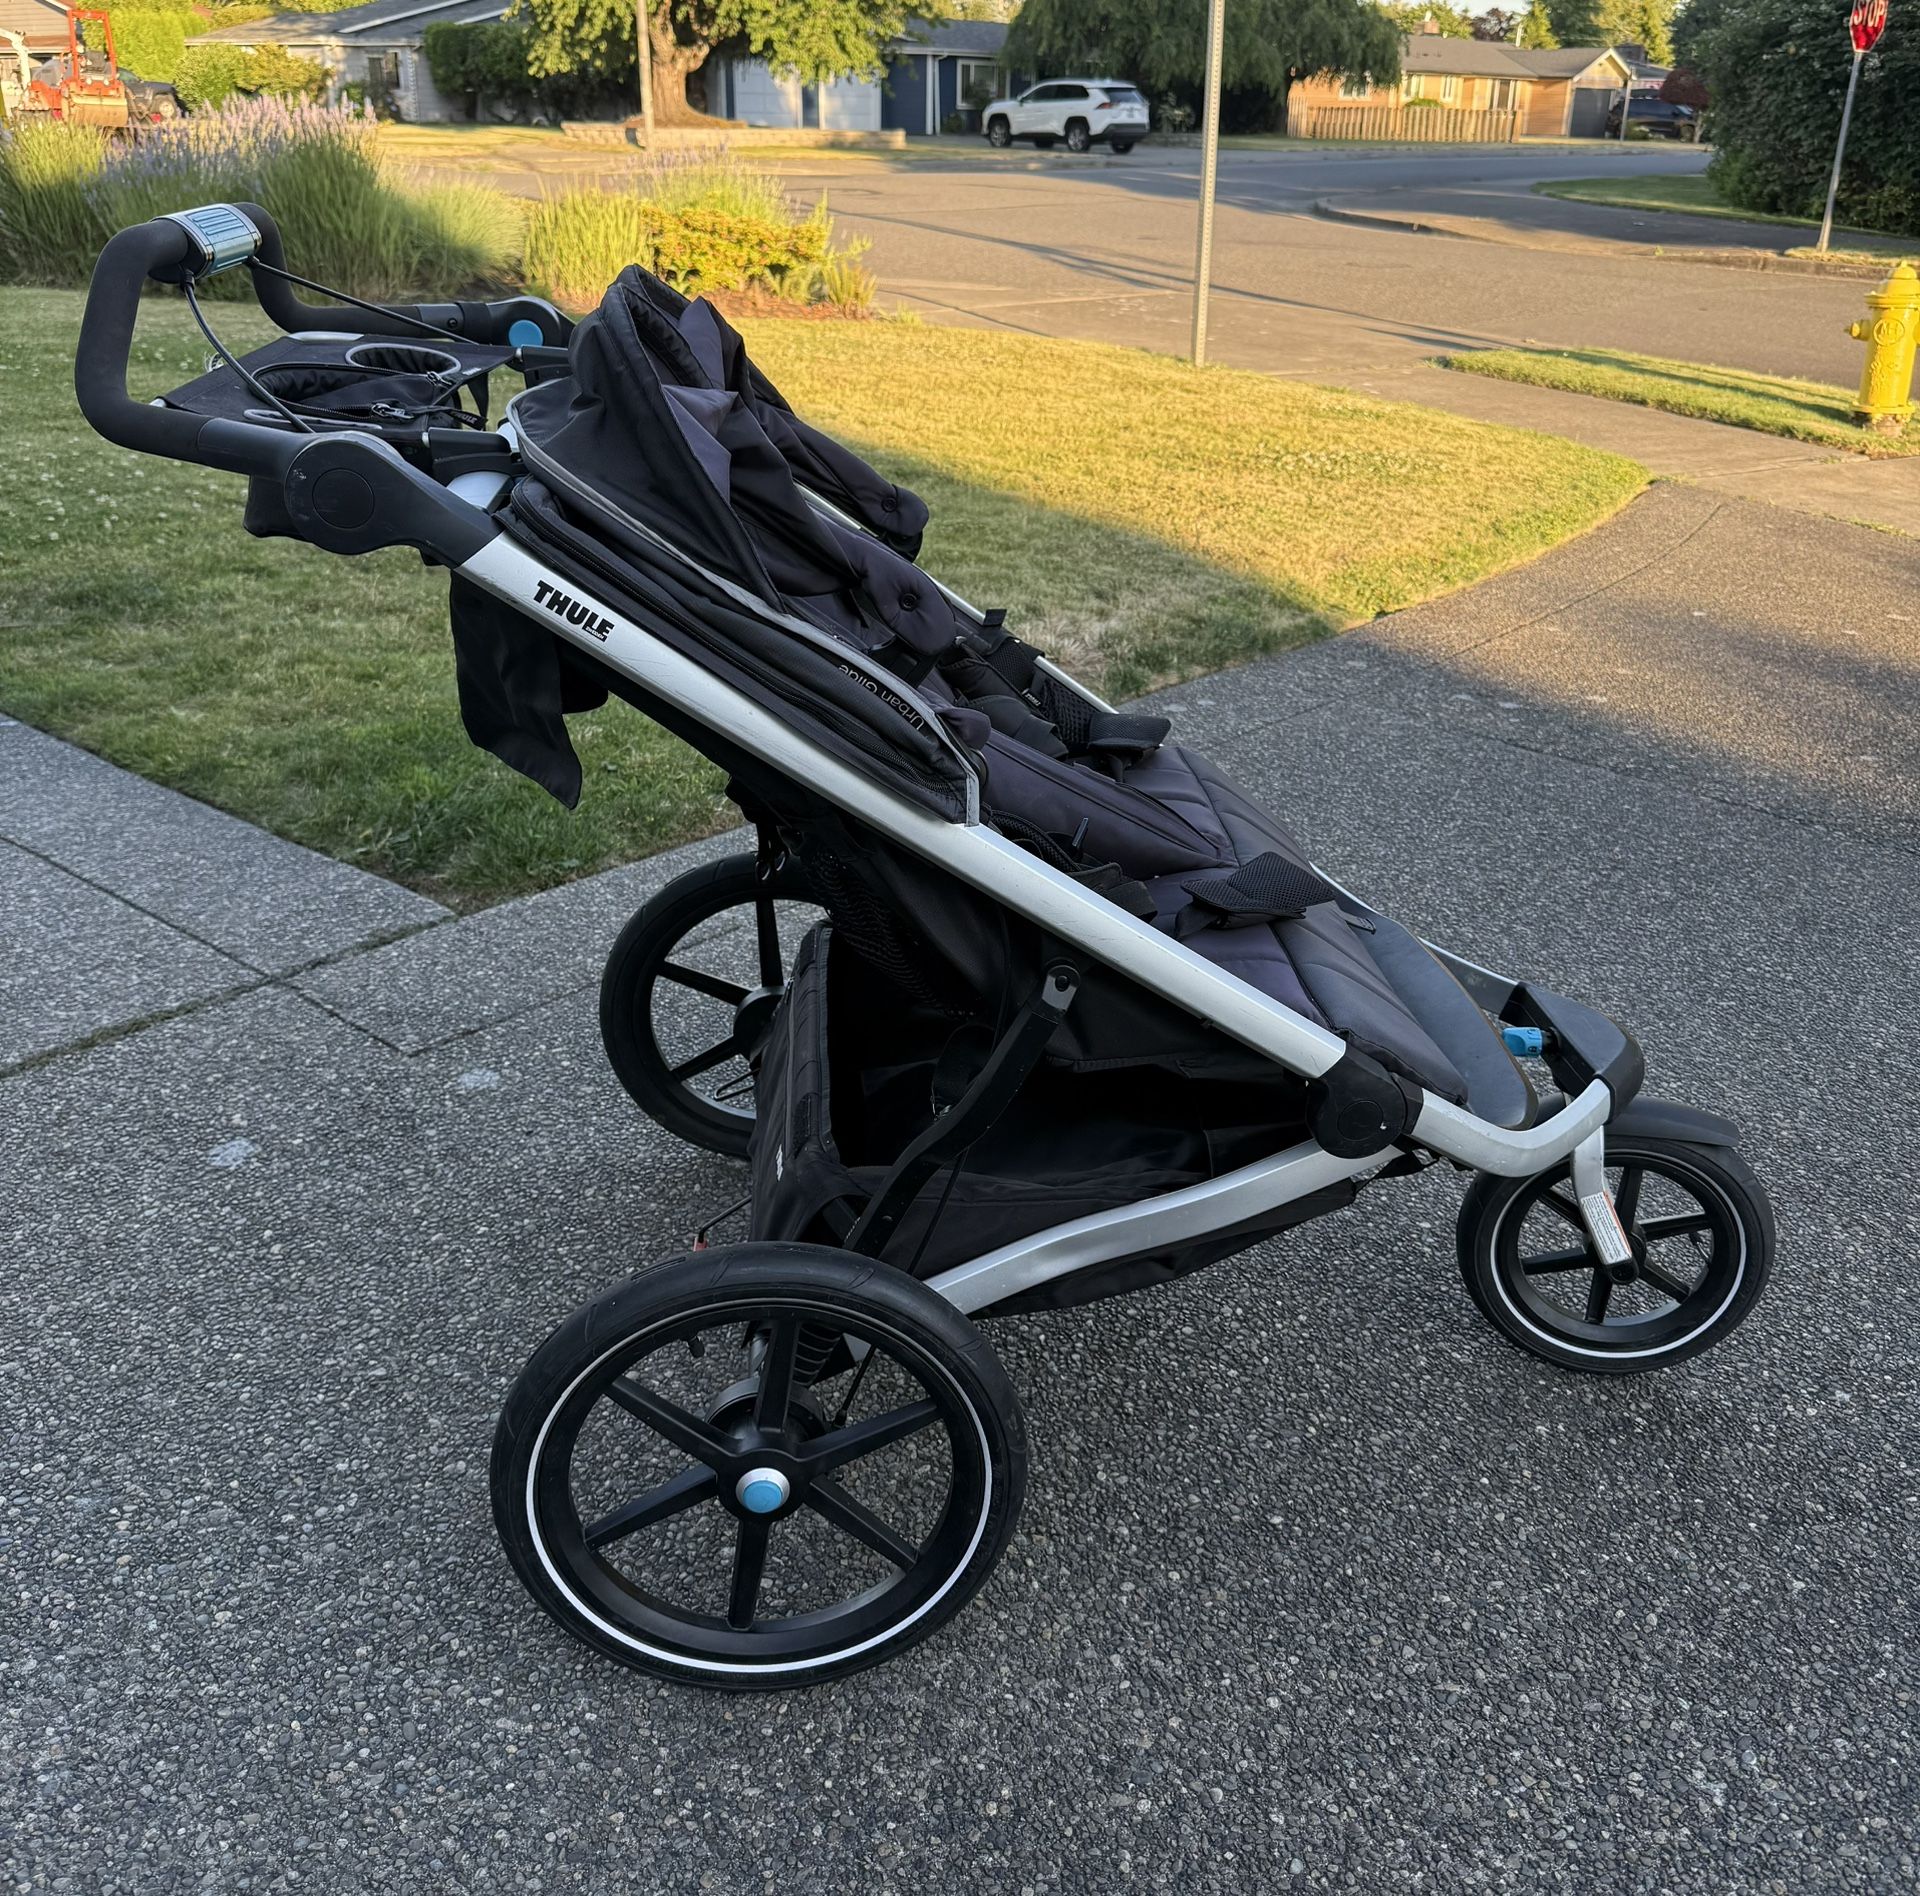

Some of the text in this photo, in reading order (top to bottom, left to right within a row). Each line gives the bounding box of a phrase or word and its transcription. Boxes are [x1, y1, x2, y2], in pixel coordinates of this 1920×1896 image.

[1853, 0, 1885, 27] STOP
[533, 579, 615, 642] THULE
[881, 690, 925, 731] Urban
